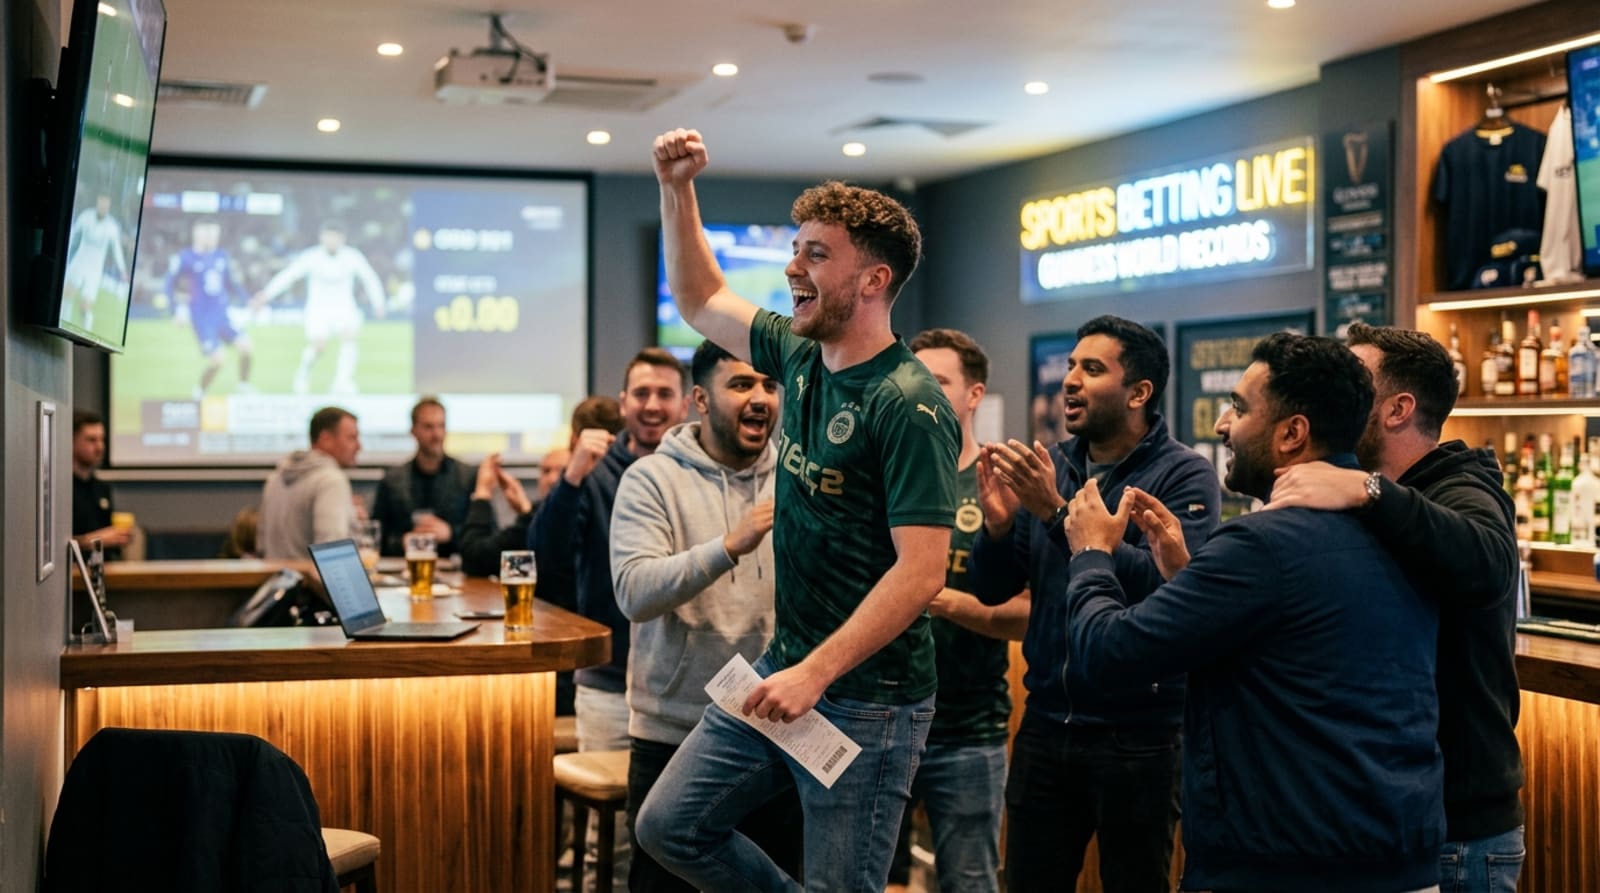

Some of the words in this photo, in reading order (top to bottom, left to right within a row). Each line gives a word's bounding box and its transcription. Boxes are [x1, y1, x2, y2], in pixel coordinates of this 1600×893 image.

[1020, 186, 1117, 251] SPORTS
[1116, 162, 1233, 233] BETTING
[1235, 146, 1307, 212] LIVE
